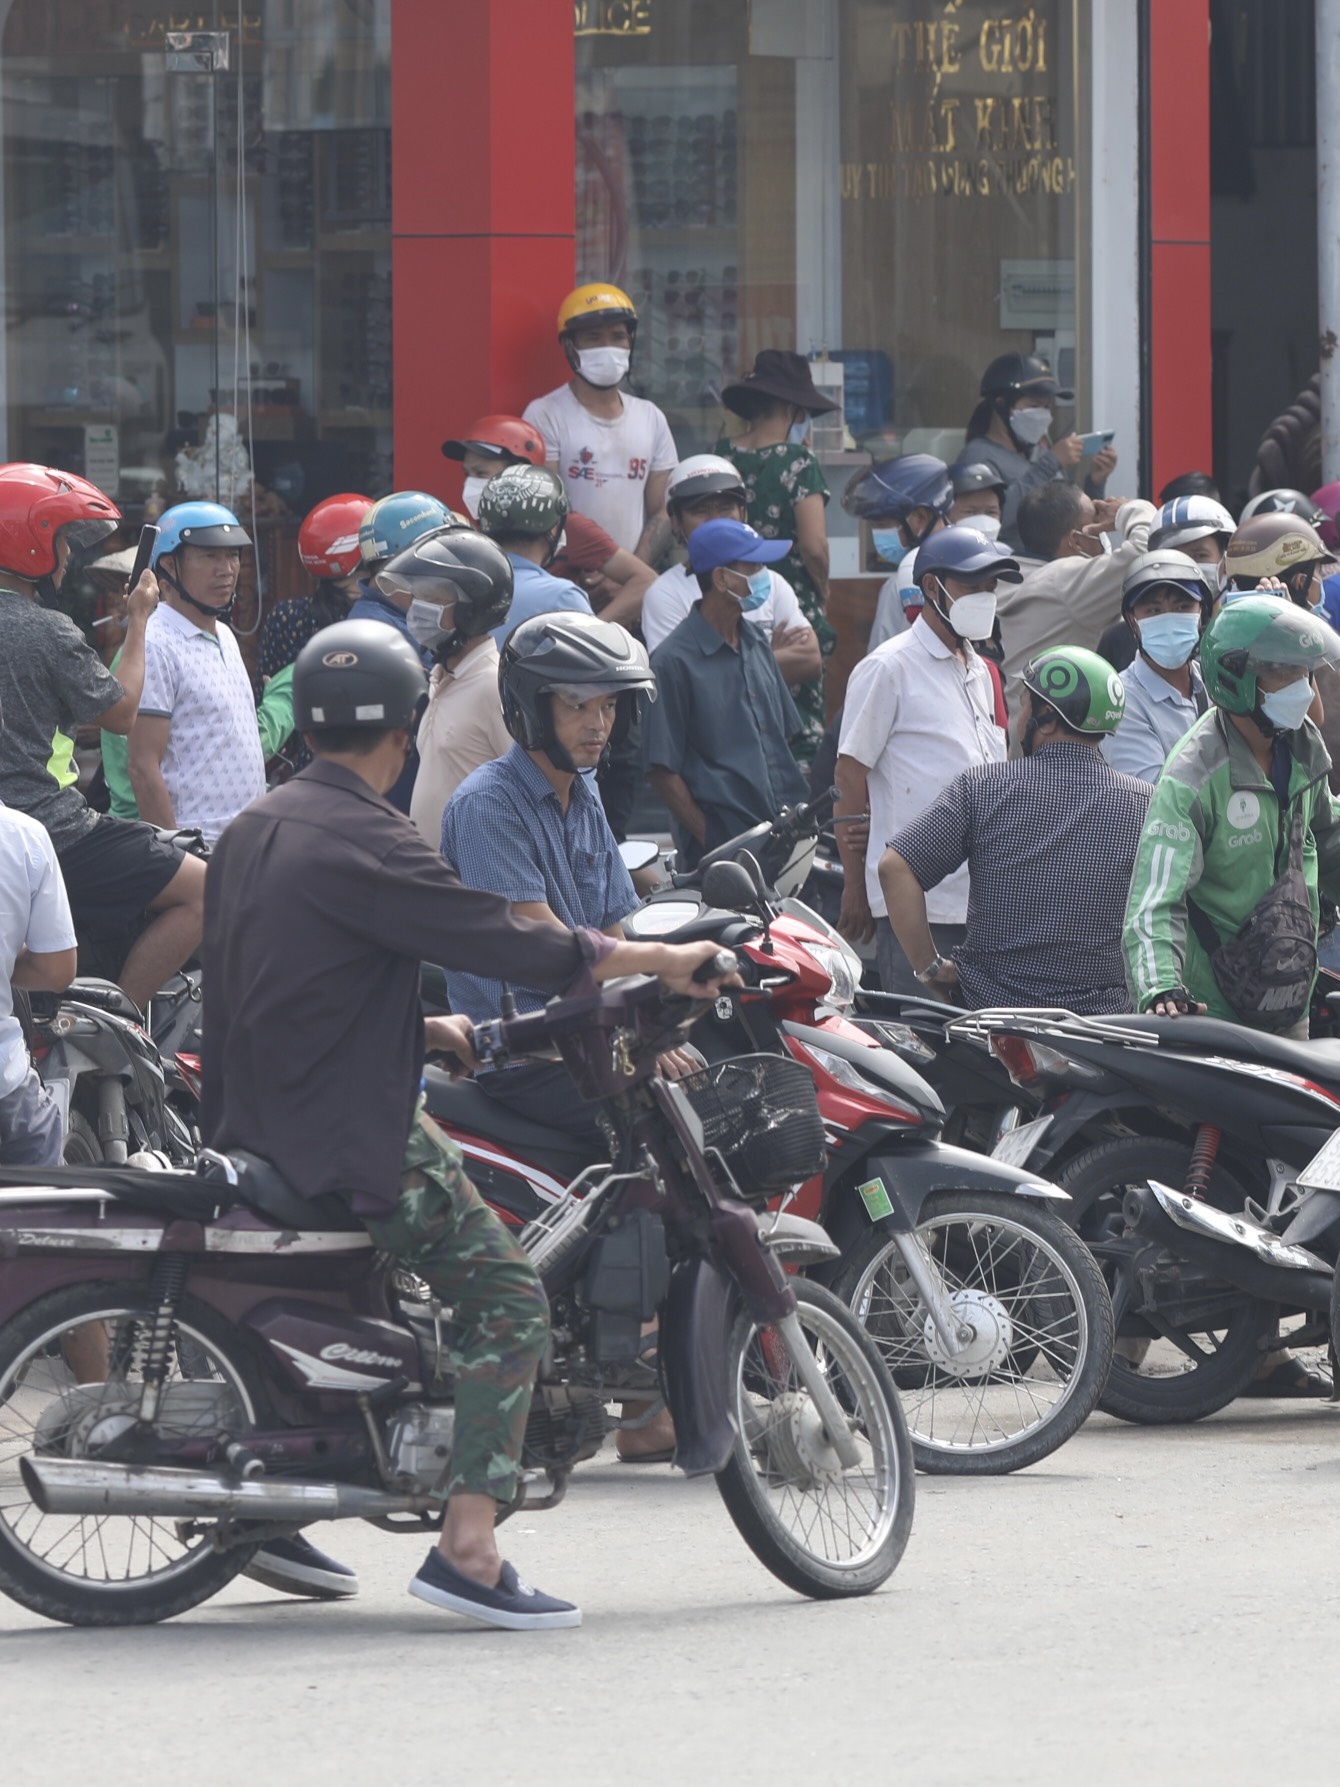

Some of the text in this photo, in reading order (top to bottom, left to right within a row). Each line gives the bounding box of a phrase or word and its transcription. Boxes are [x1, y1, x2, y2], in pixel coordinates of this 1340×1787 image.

[628, 458, 647, 480] 95
[1147, 818, 1190, 841] Grab
[1228, 829, 1263, 848] Grab
[1257, 982, 1306, 1011] NIKE
